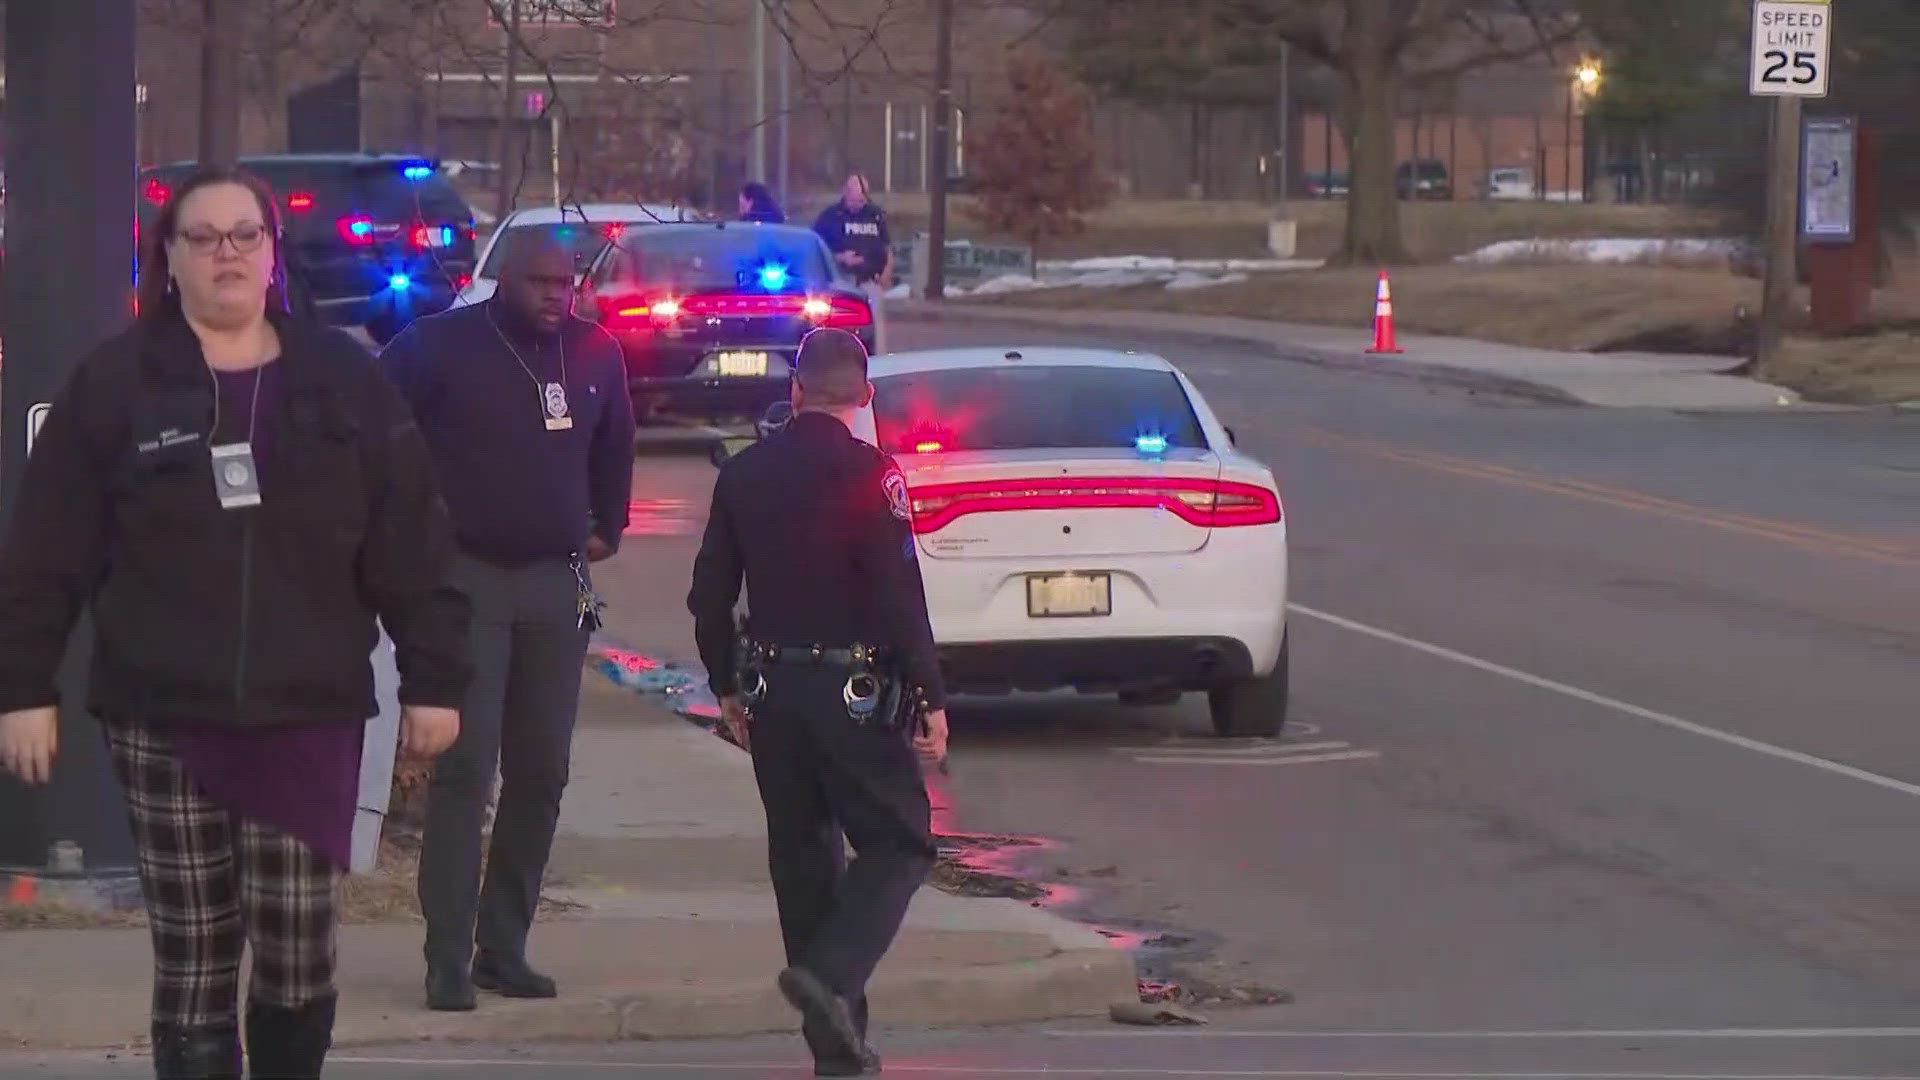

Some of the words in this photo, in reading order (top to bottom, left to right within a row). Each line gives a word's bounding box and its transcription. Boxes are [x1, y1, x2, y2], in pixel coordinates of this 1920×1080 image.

[1762, 11, 1823, 27] SPEED
[1767, 31, 1815, 46] LIMIT
[1762, 51, 1817, 84] 25
[844, 222, 878, 236] POLICE
